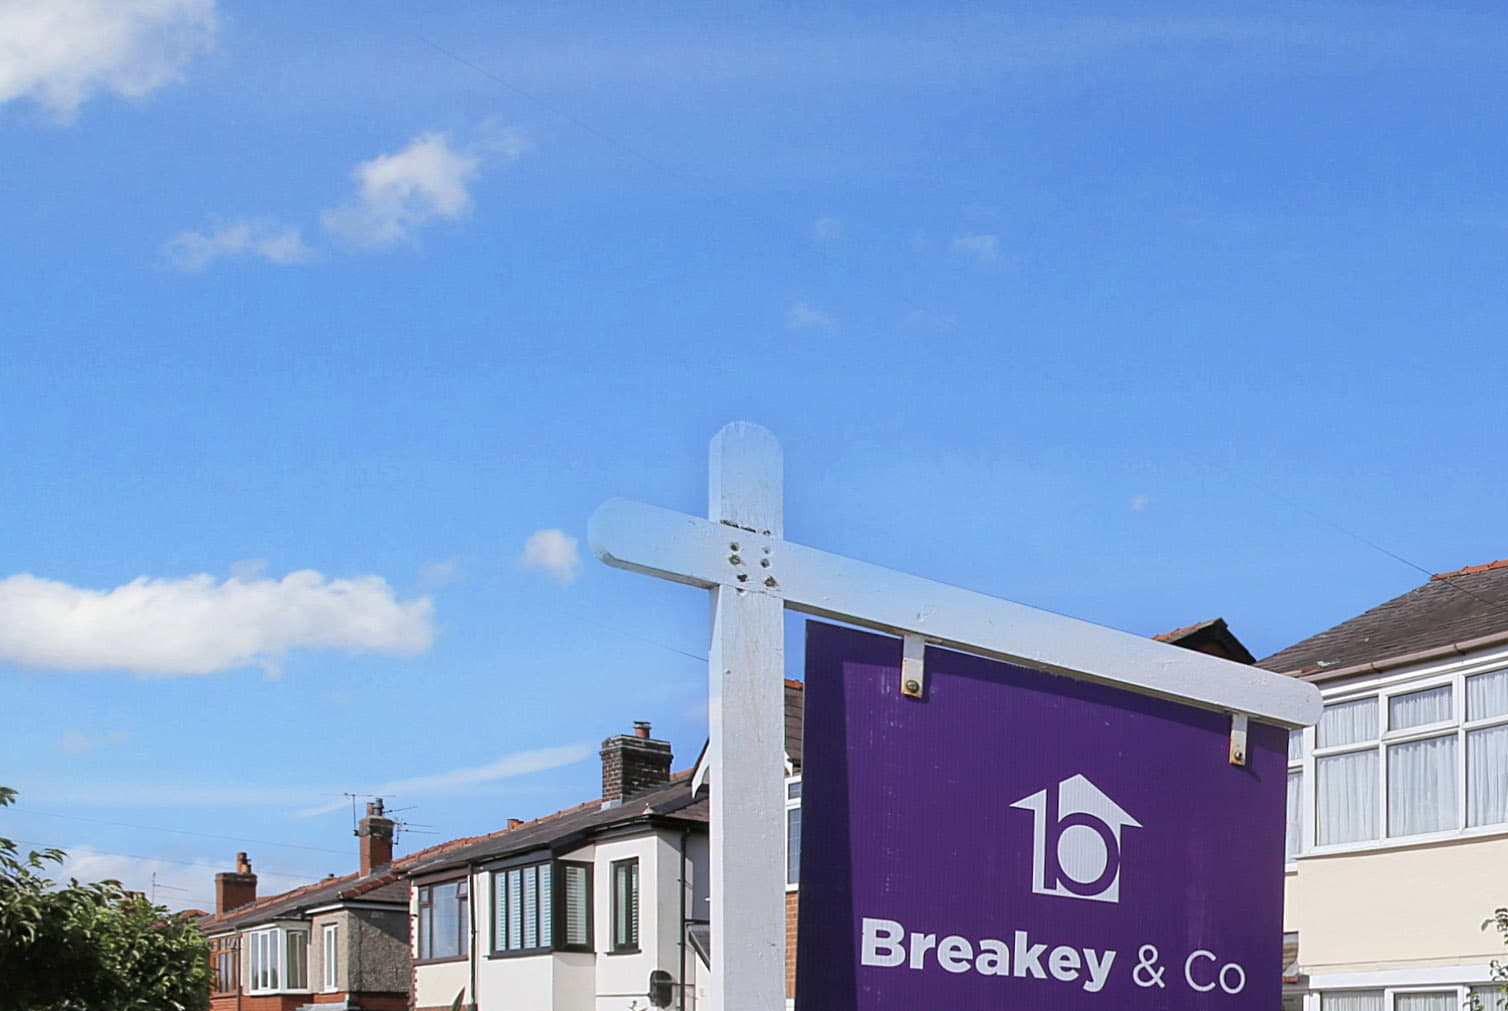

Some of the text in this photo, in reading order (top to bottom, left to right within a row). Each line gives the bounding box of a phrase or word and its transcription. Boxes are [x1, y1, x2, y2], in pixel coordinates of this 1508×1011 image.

[859, 916, 1247, 995] Breakey & Co
